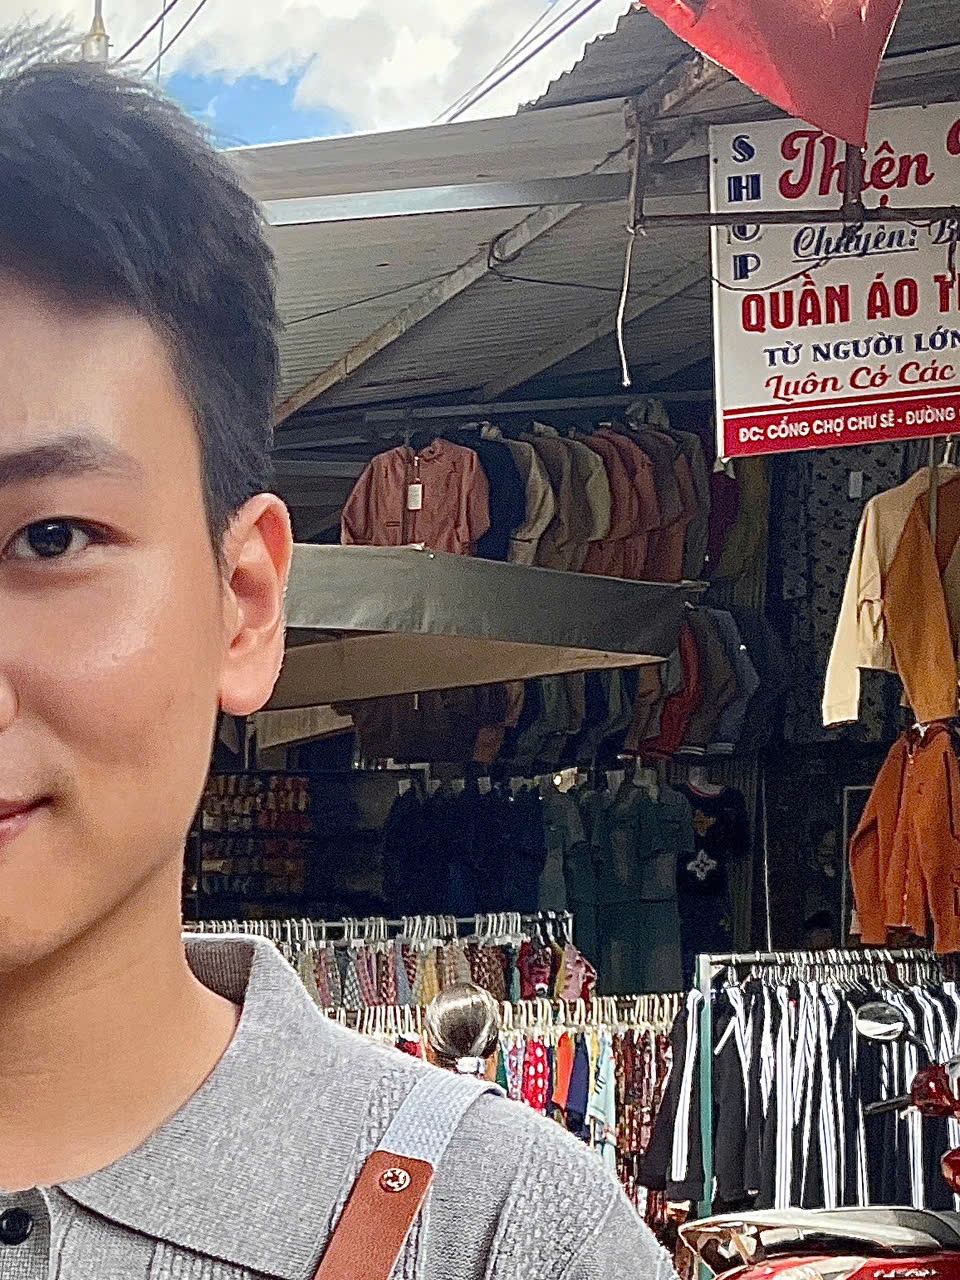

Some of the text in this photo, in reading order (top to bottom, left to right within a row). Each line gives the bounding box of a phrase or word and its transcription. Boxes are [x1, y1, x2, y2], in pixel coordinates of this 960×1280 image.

[742, 271, 960, 333] QUẦN ÁO T
[764, 340, 803, 367] TỪ
[812, 331, 904, 363] NGƯỜI
[764, 359, 957, 402] Luôn Có Các
[766, 415, 810, 439] CỔNG
[812, 417, 845, 437] CHỢ
[905, 404, 956, 426] ĐƯỜNG
